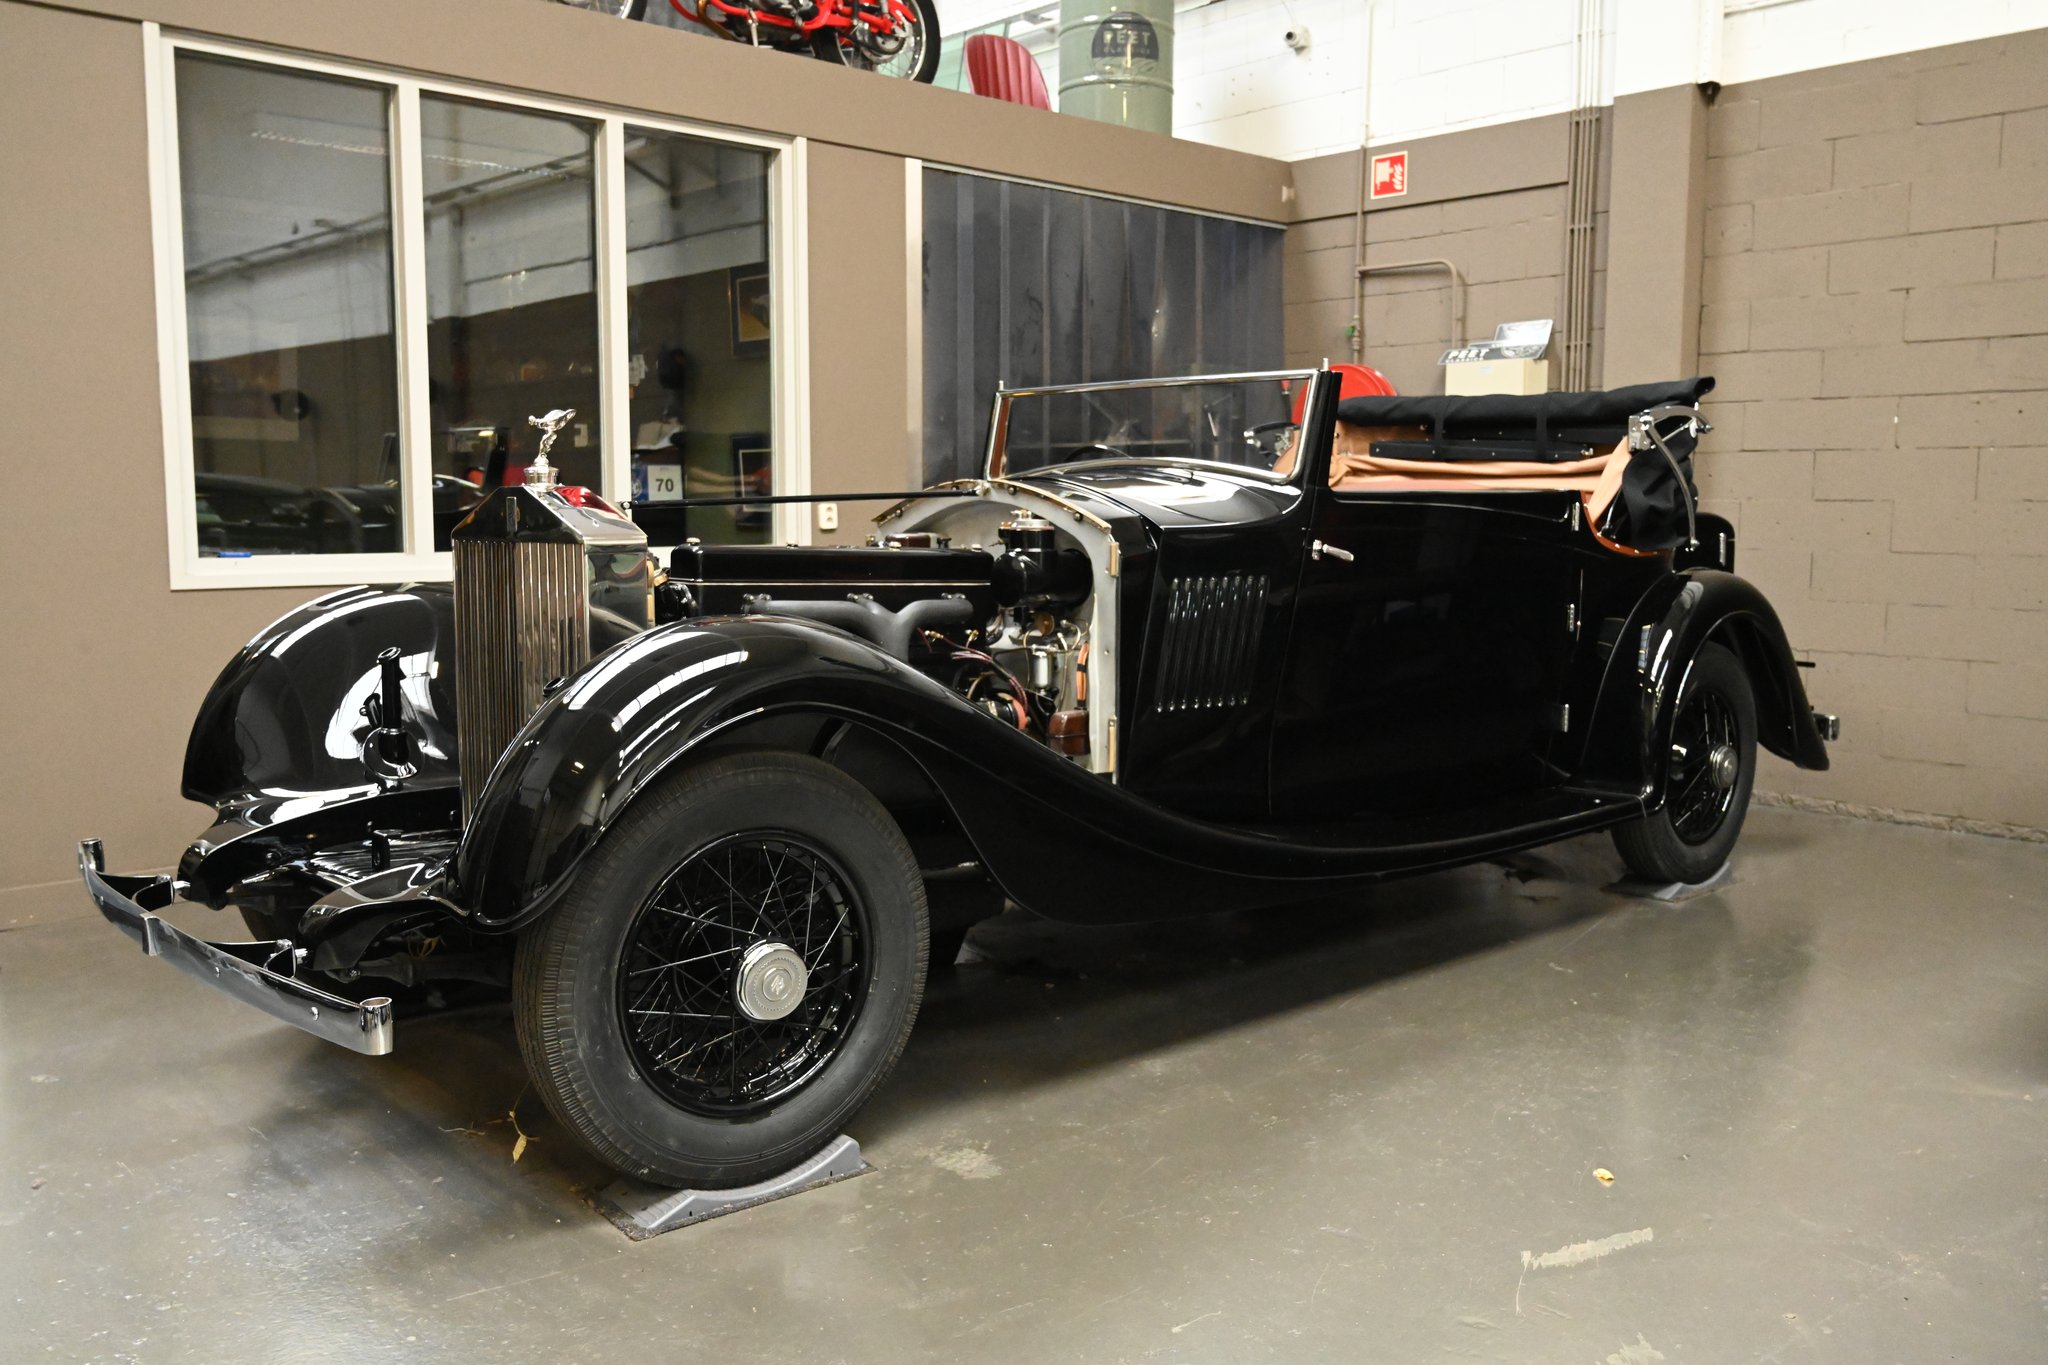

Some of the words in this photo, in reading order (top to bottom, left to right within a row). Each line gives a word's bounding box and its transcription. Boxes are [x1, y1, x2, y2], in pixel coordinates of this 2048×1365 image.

[1103, 30, 1151, 46] PEET
[1448, 348, 1490, 359] PEET
[655, 478, 674, 492] 70
